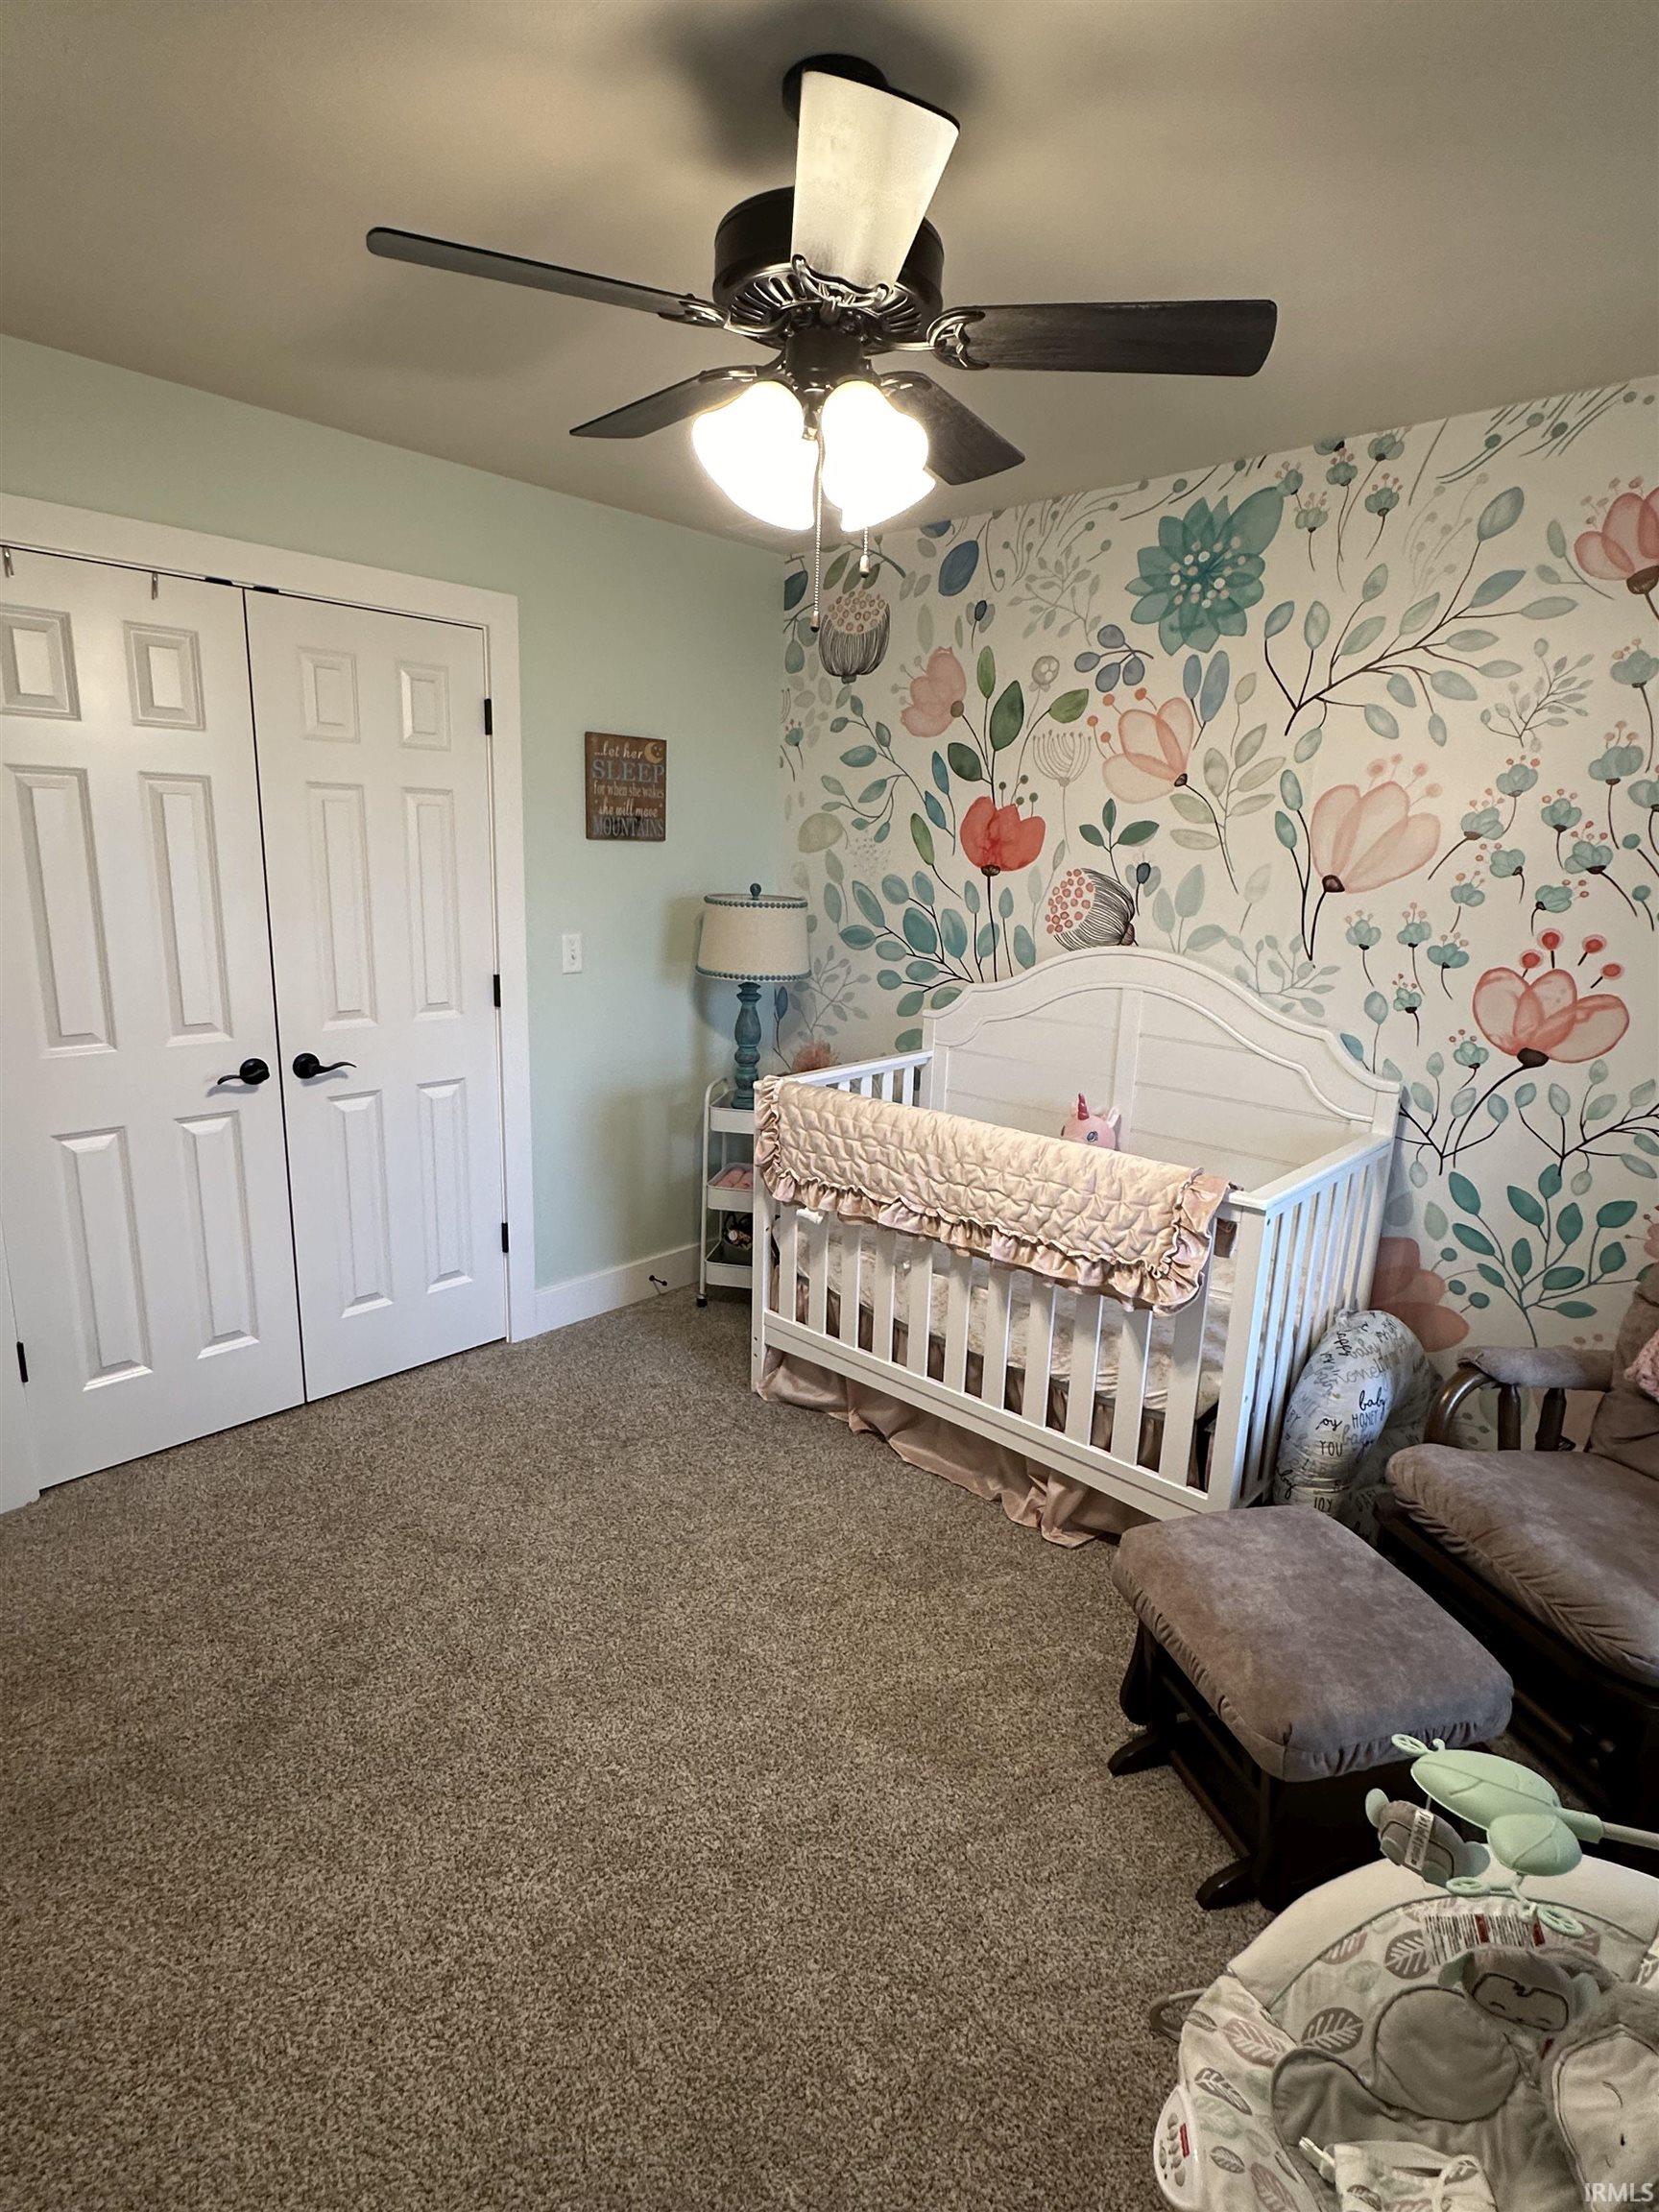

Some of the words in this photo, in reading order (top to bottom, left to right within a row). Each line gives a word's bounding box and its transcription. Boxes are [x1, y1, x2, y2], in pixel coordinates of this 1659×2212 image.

[623, 741, 643, 759] her
[592, 758, 664, 783] SLEEP
[608, 781, 627, 797] when
[615, 798, 635, 817] will
[636, 807, 659, 818] move
[592, 816, 664, 838] MOUNTAINS
[1358, 1386, 1386, 1421] baby
[1319, 1440, 1343, 1457] YOU
